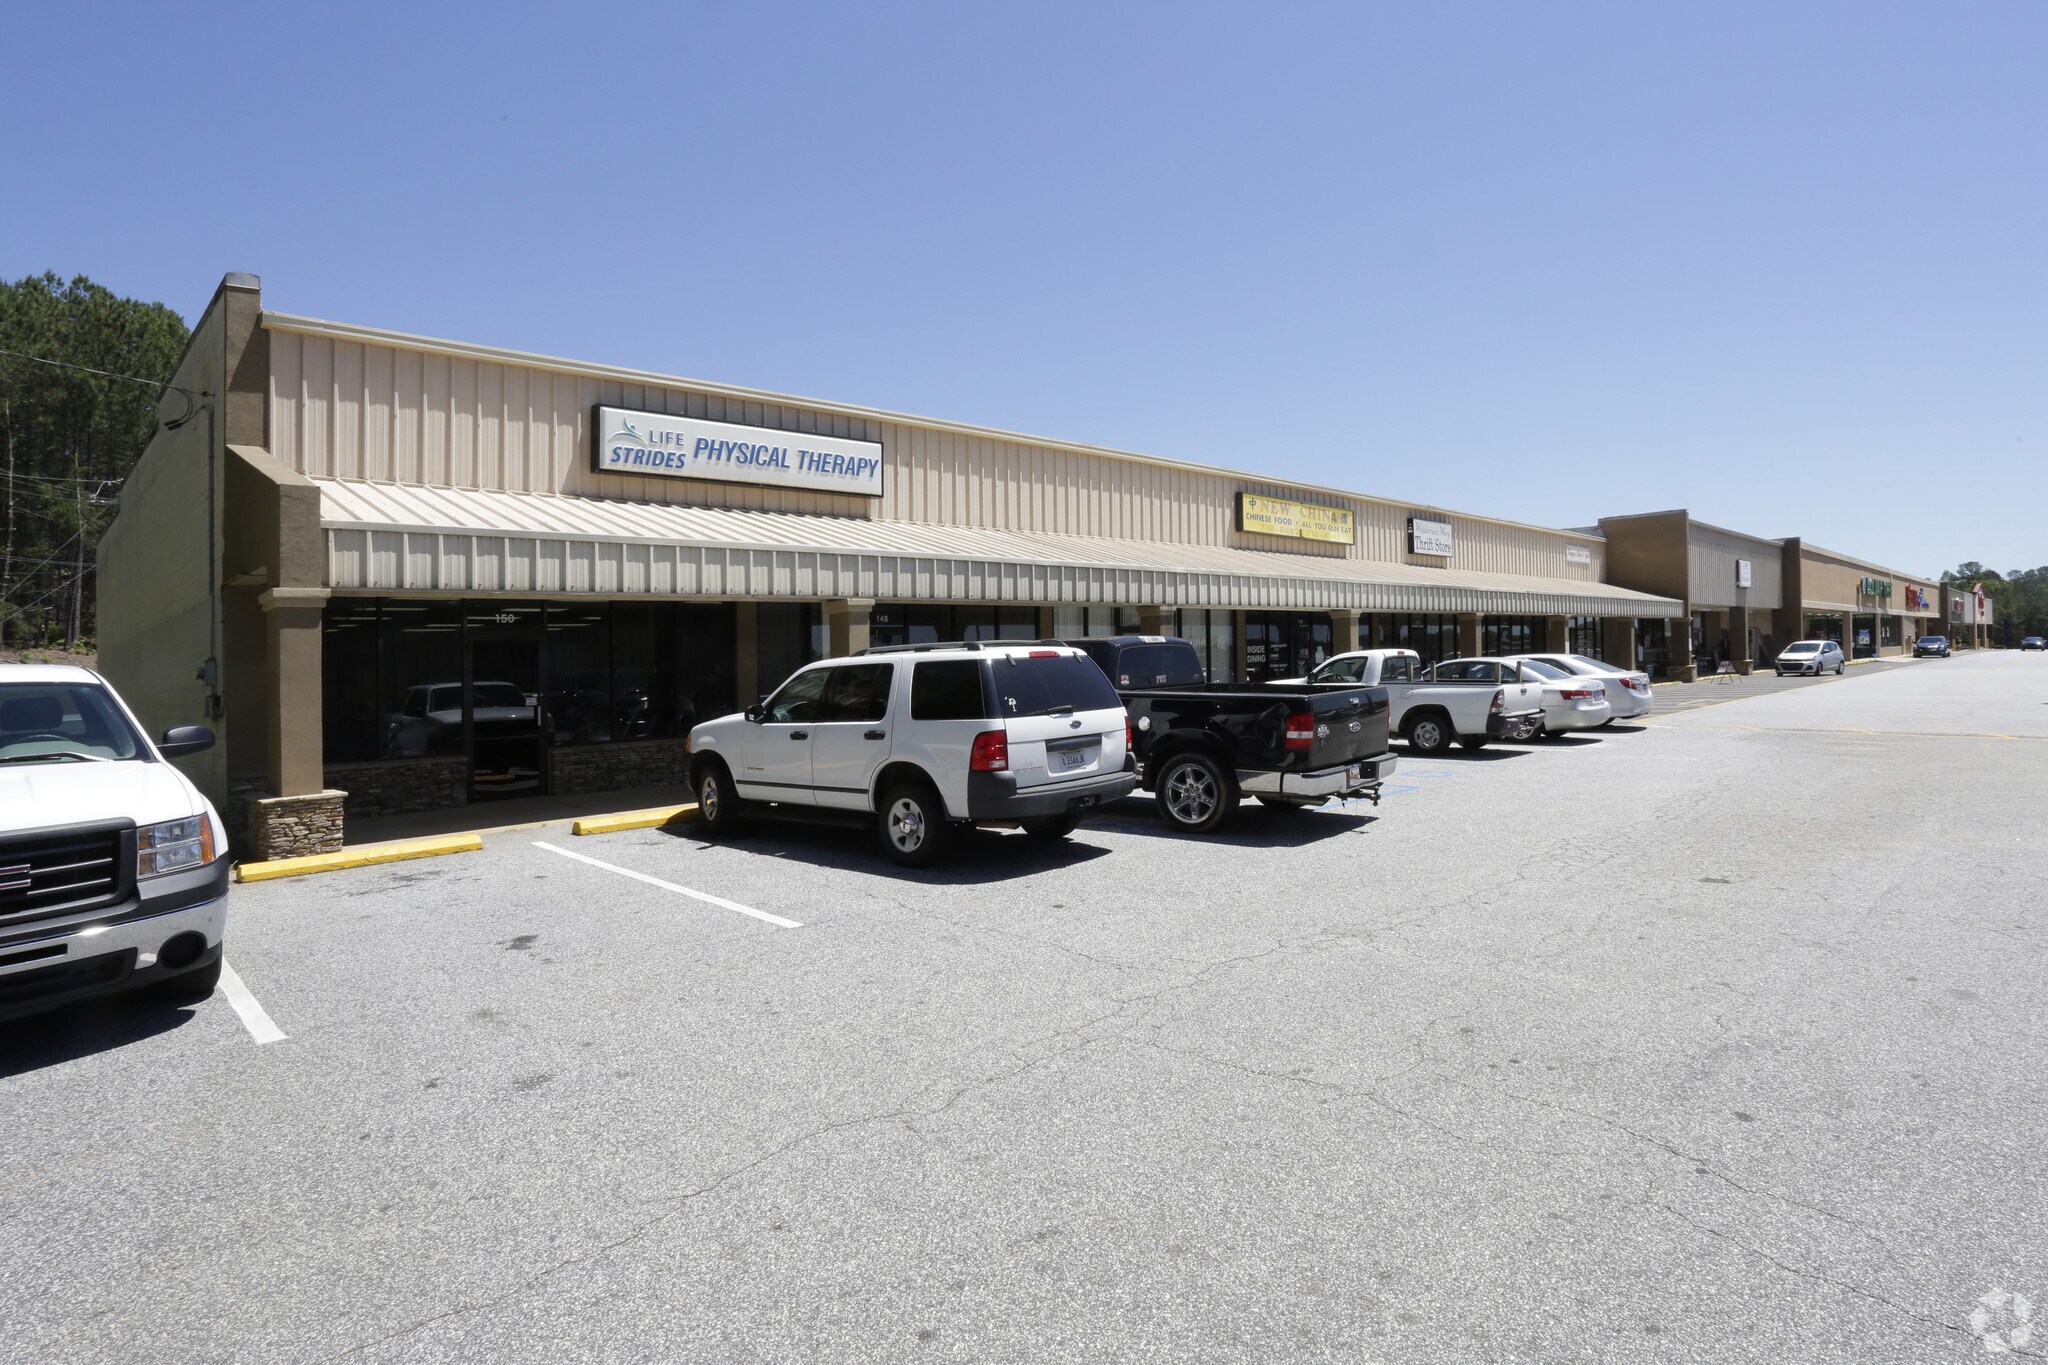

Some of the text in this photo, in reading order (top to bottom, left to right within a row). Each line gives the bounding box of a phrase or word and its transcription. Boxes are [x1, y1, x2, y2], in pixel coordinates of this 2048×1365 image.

[650, 429, 685, 446] LIFE
[610, 446, 687, 469] STRIDES
[693, 437, 880, 479] PHYSICAL THERAPY
[1260, 499, 1338, 524] NEW CHINA
[1246, 512, 1293, 526] CHINESE FOOD
[1302, 520, 1351, 534] ALL YOU CAN EAT
[1415, 535, 1452, 553] Thrift Store
[495, 613, 515, 624] 150
[876, 614, 889, 623] 148
[1247, 645, 1266, 654] INSIDE
[1247, 654, 1266, 663] DINING
